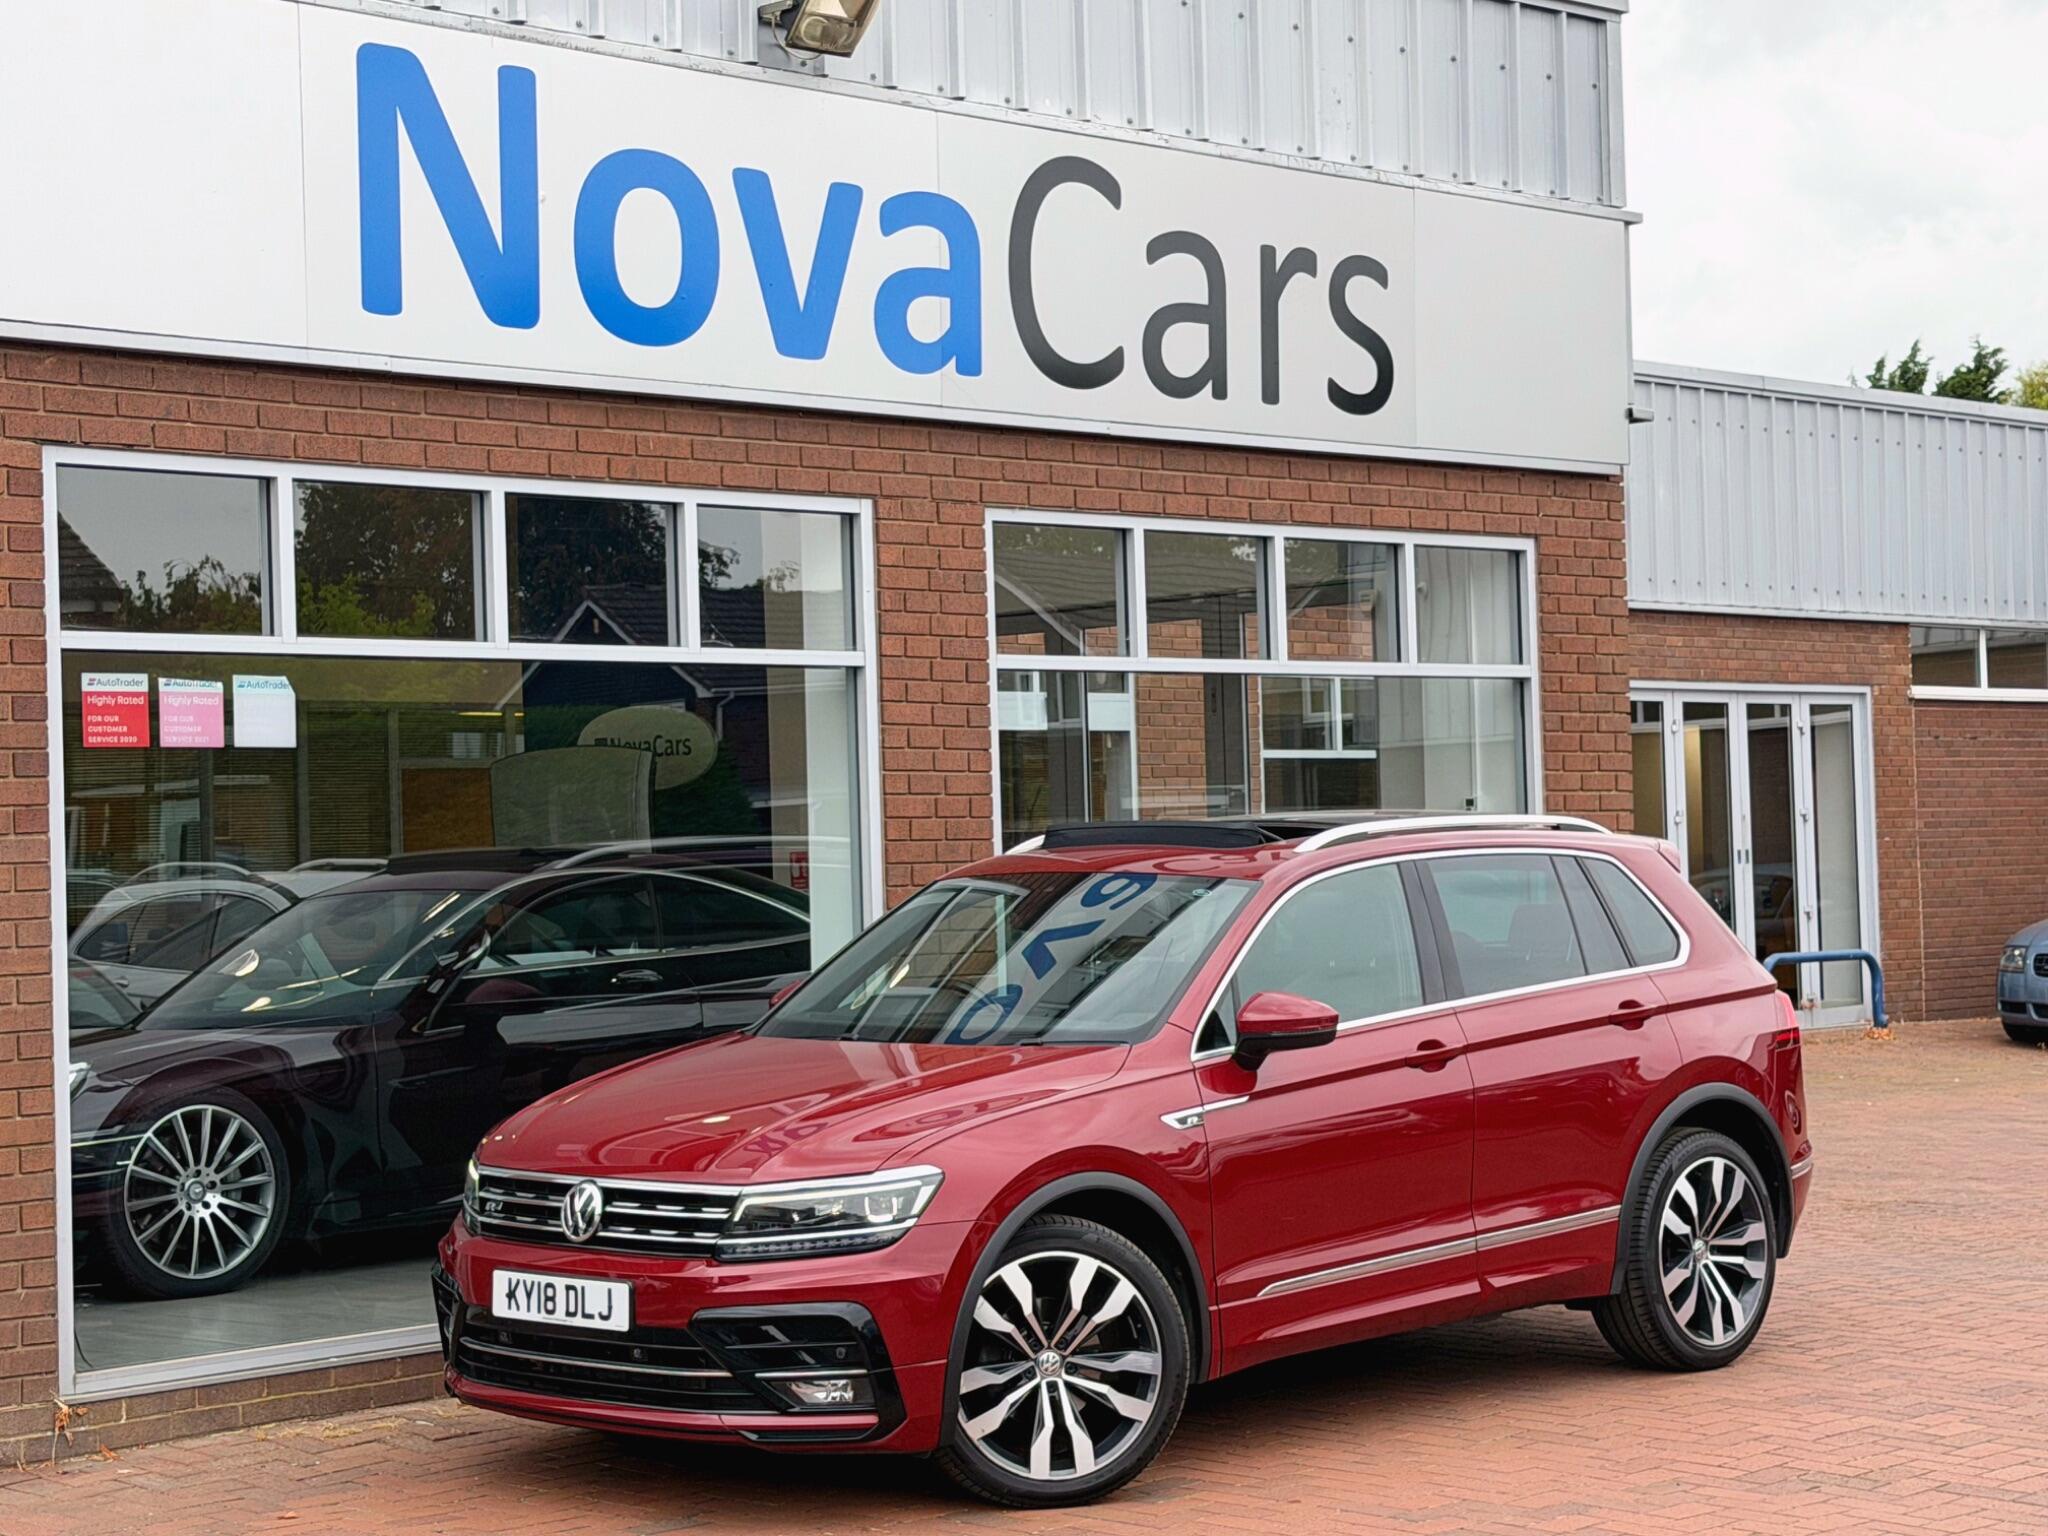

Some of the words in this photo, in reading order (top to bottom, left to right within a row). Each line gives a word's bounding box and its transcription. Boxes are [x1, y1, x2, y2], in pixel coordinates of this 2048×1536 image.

[357, 42, 1394, 416] NovaCars
[96, 678, 144, 687] AutoTrader
[246, 680, 290, 690] AutoTrade
[87, 695, 116, 707] Highly
[117, 695, 145, 705] Rated
[87, 725, 128, 733] CUSTOMER
[87, 735, 118, 743] SERVICE
[505, 1277, 557, 1315] KY18
[565, 1284, 613, 1321] DLJ
